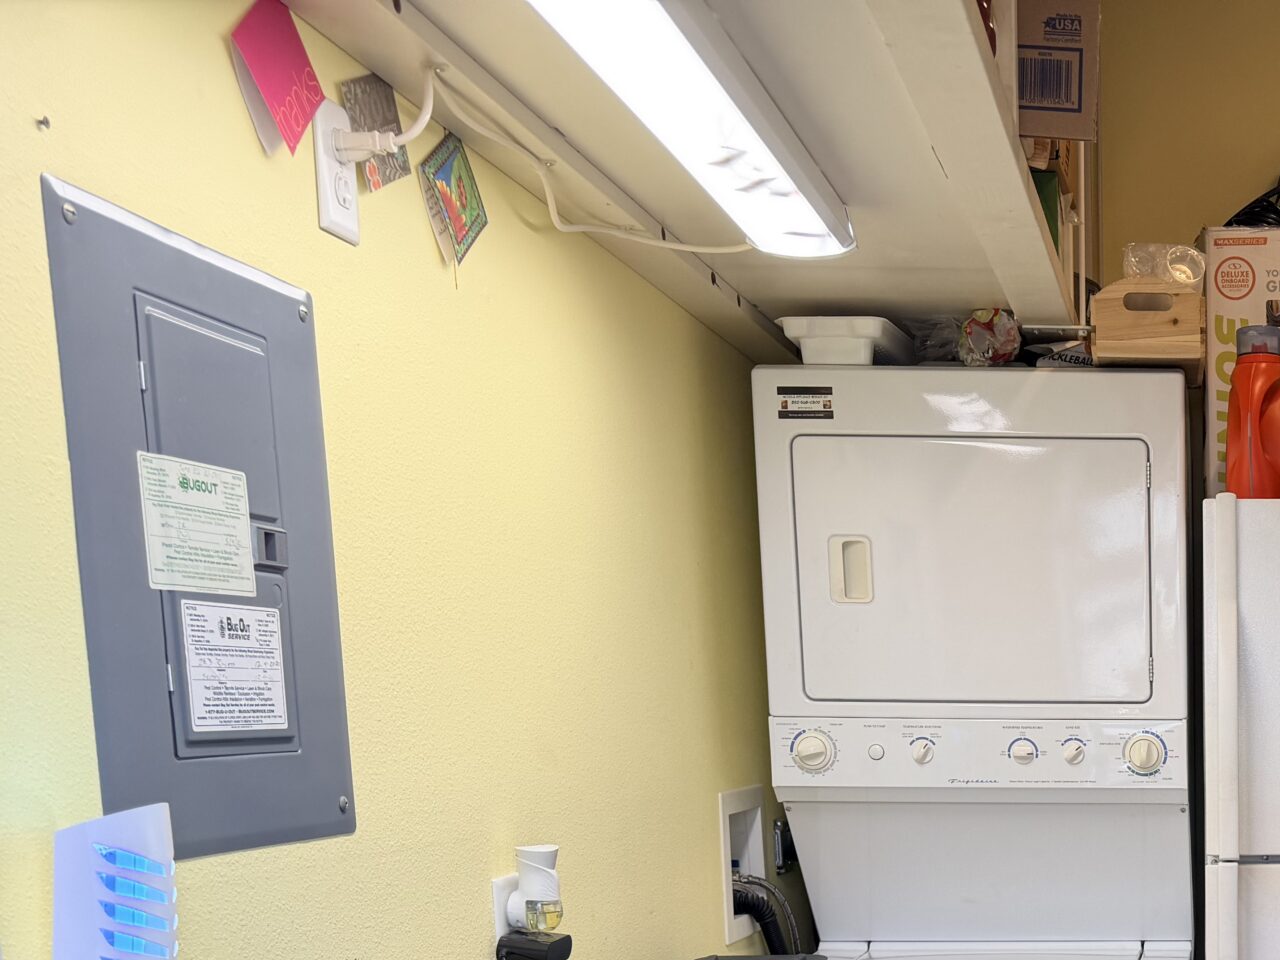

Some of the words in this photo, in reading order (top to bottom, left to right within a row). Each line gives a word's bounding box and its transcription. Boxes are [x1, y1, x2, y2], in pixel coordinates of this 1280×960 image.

[1056, 20, 1080, 30] USA
[276, 67, 323, 148] thanks
[1220, 270, 1249, 278] DELUXE
[1042, 350, 1094, 366] ICKLEBALL
[180, 476, 218, 495] BUGOUT
